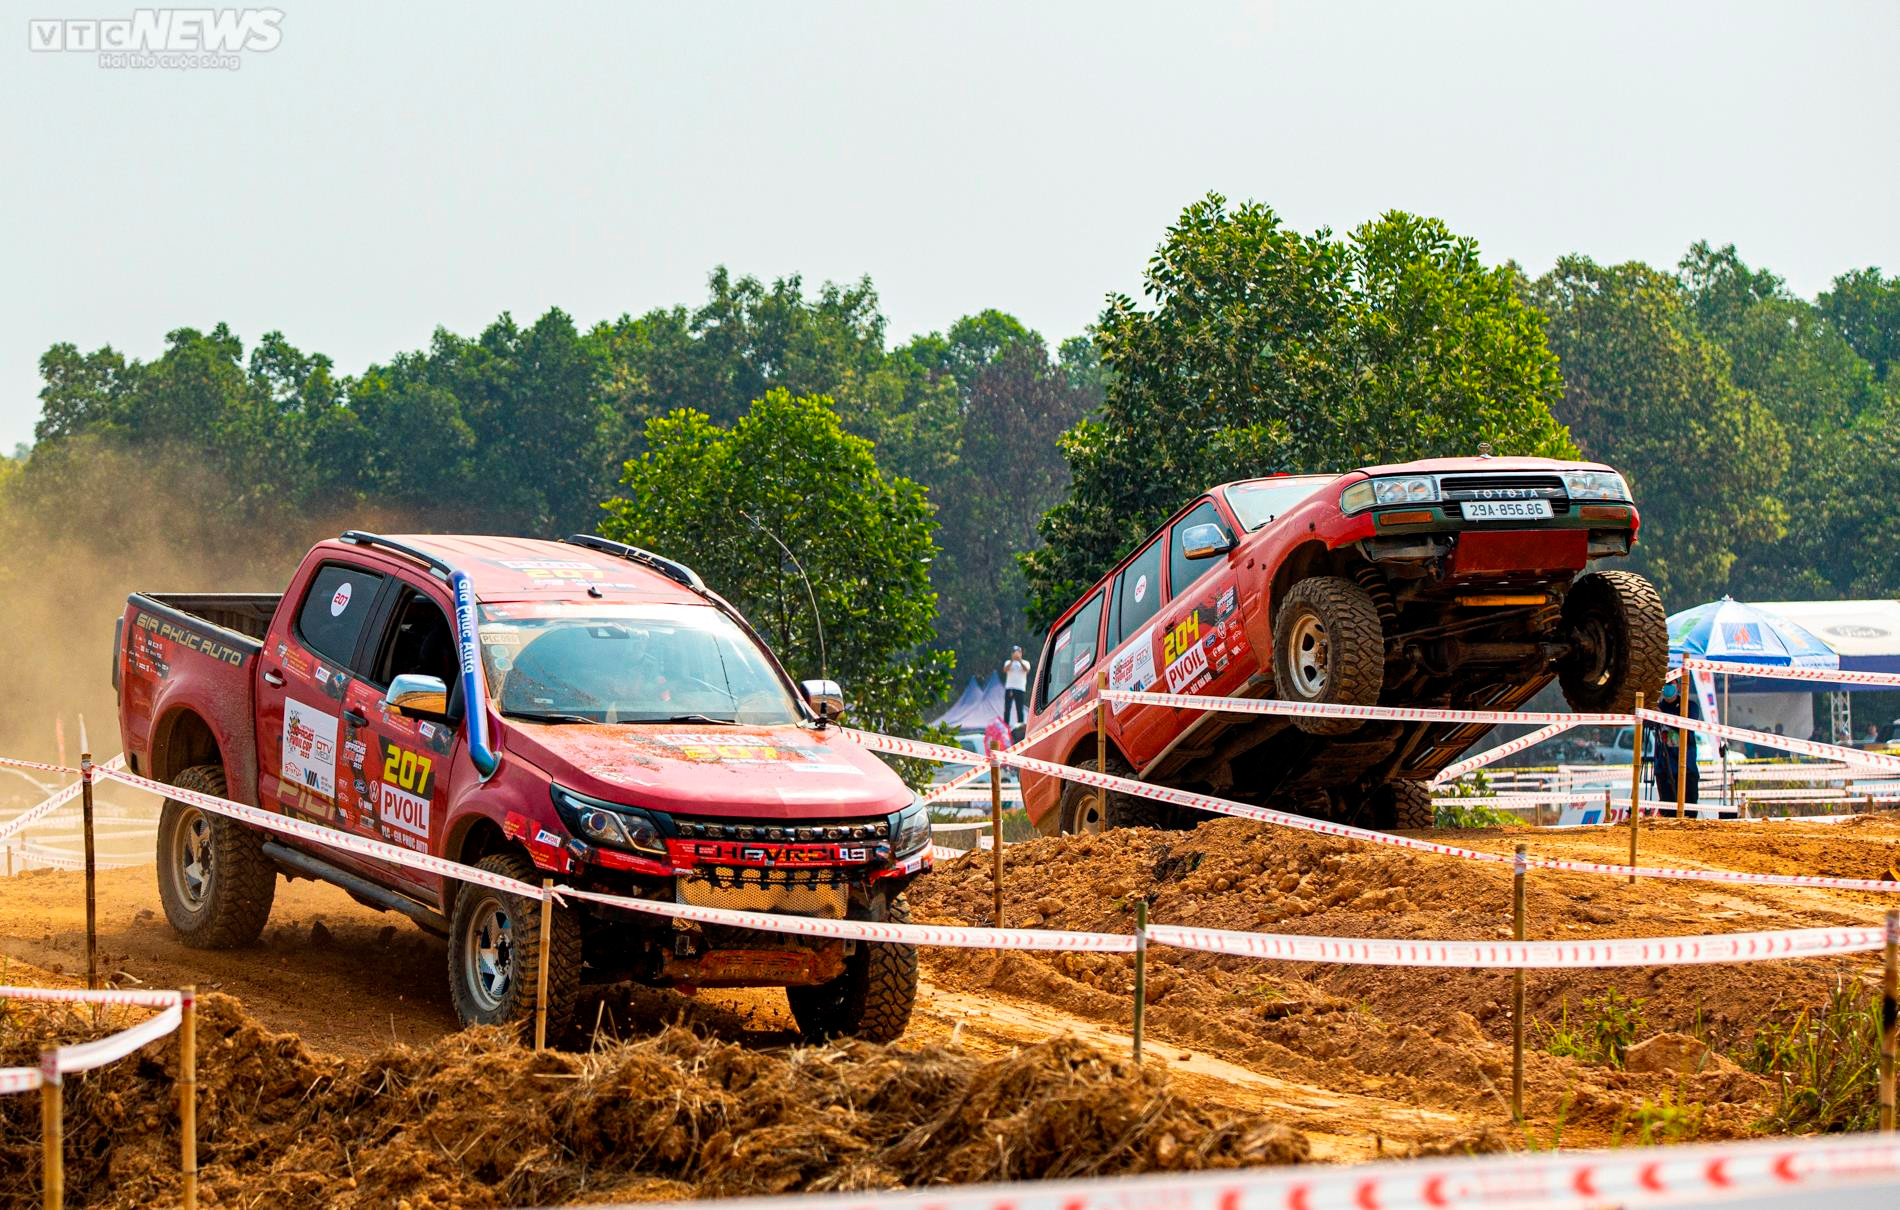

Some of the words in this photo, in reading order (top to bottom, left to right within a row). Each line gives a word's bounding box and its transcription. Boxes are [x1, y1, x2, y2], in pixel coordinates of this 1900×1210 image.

[1471, 489, 1539, 498] TOYOTA
[1470, 504, 1544, 516] 29A-856.86
[334, 593, 349, 606] 207
[1163, 609, 1200, 667] 204
[200, 640, 242, 667] AUTO
[463, 641, 475, 673] Auto
[1168, 648, 1205, 689] PVOIL
[681, 746, 778, 759] 207
[383, 744, 432, 794] 207
[384, 790, 426, 831] PVOIL
